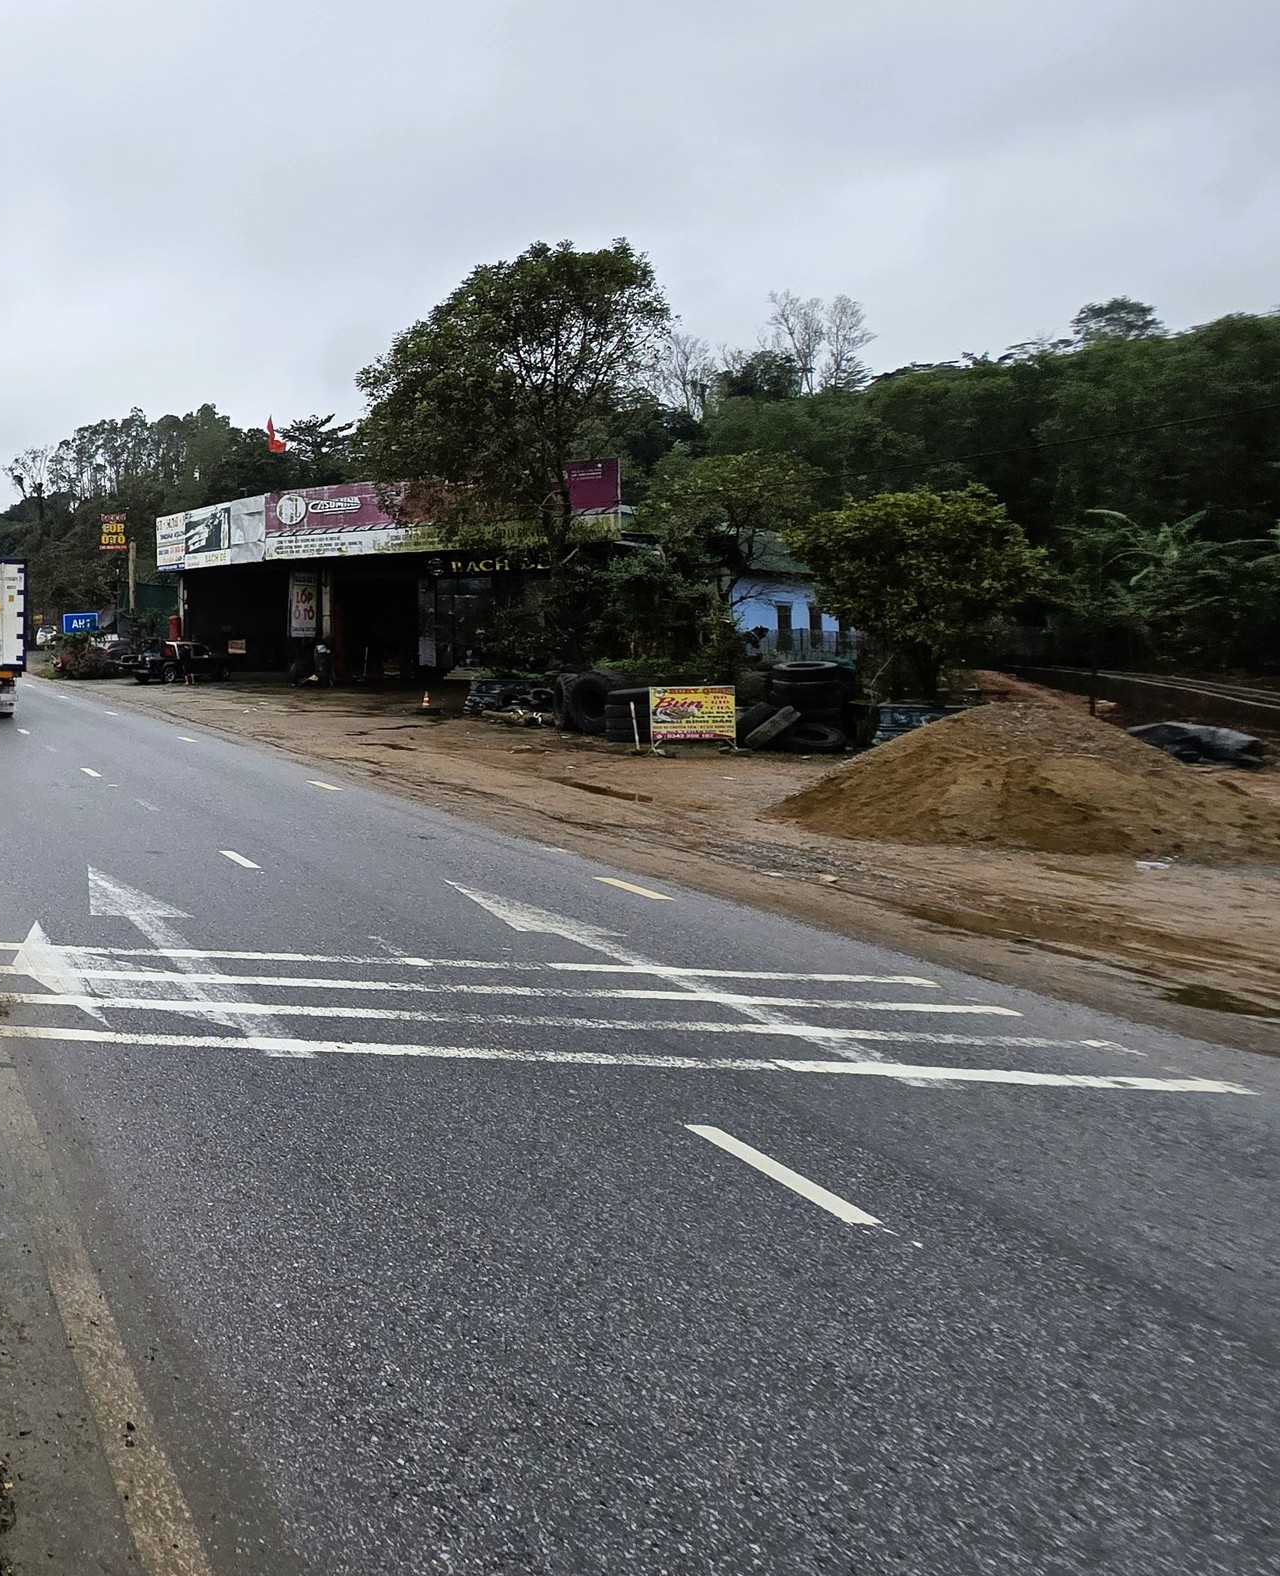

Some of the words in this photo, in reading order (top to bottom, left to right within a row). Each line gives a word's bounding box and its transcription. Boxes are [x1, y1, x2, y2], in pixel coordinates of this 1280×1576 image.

[308, 496, 361, 513] CASUMINA
[71, 618, 91, 629] AH1
[654, 696, 703, 709] Bún
